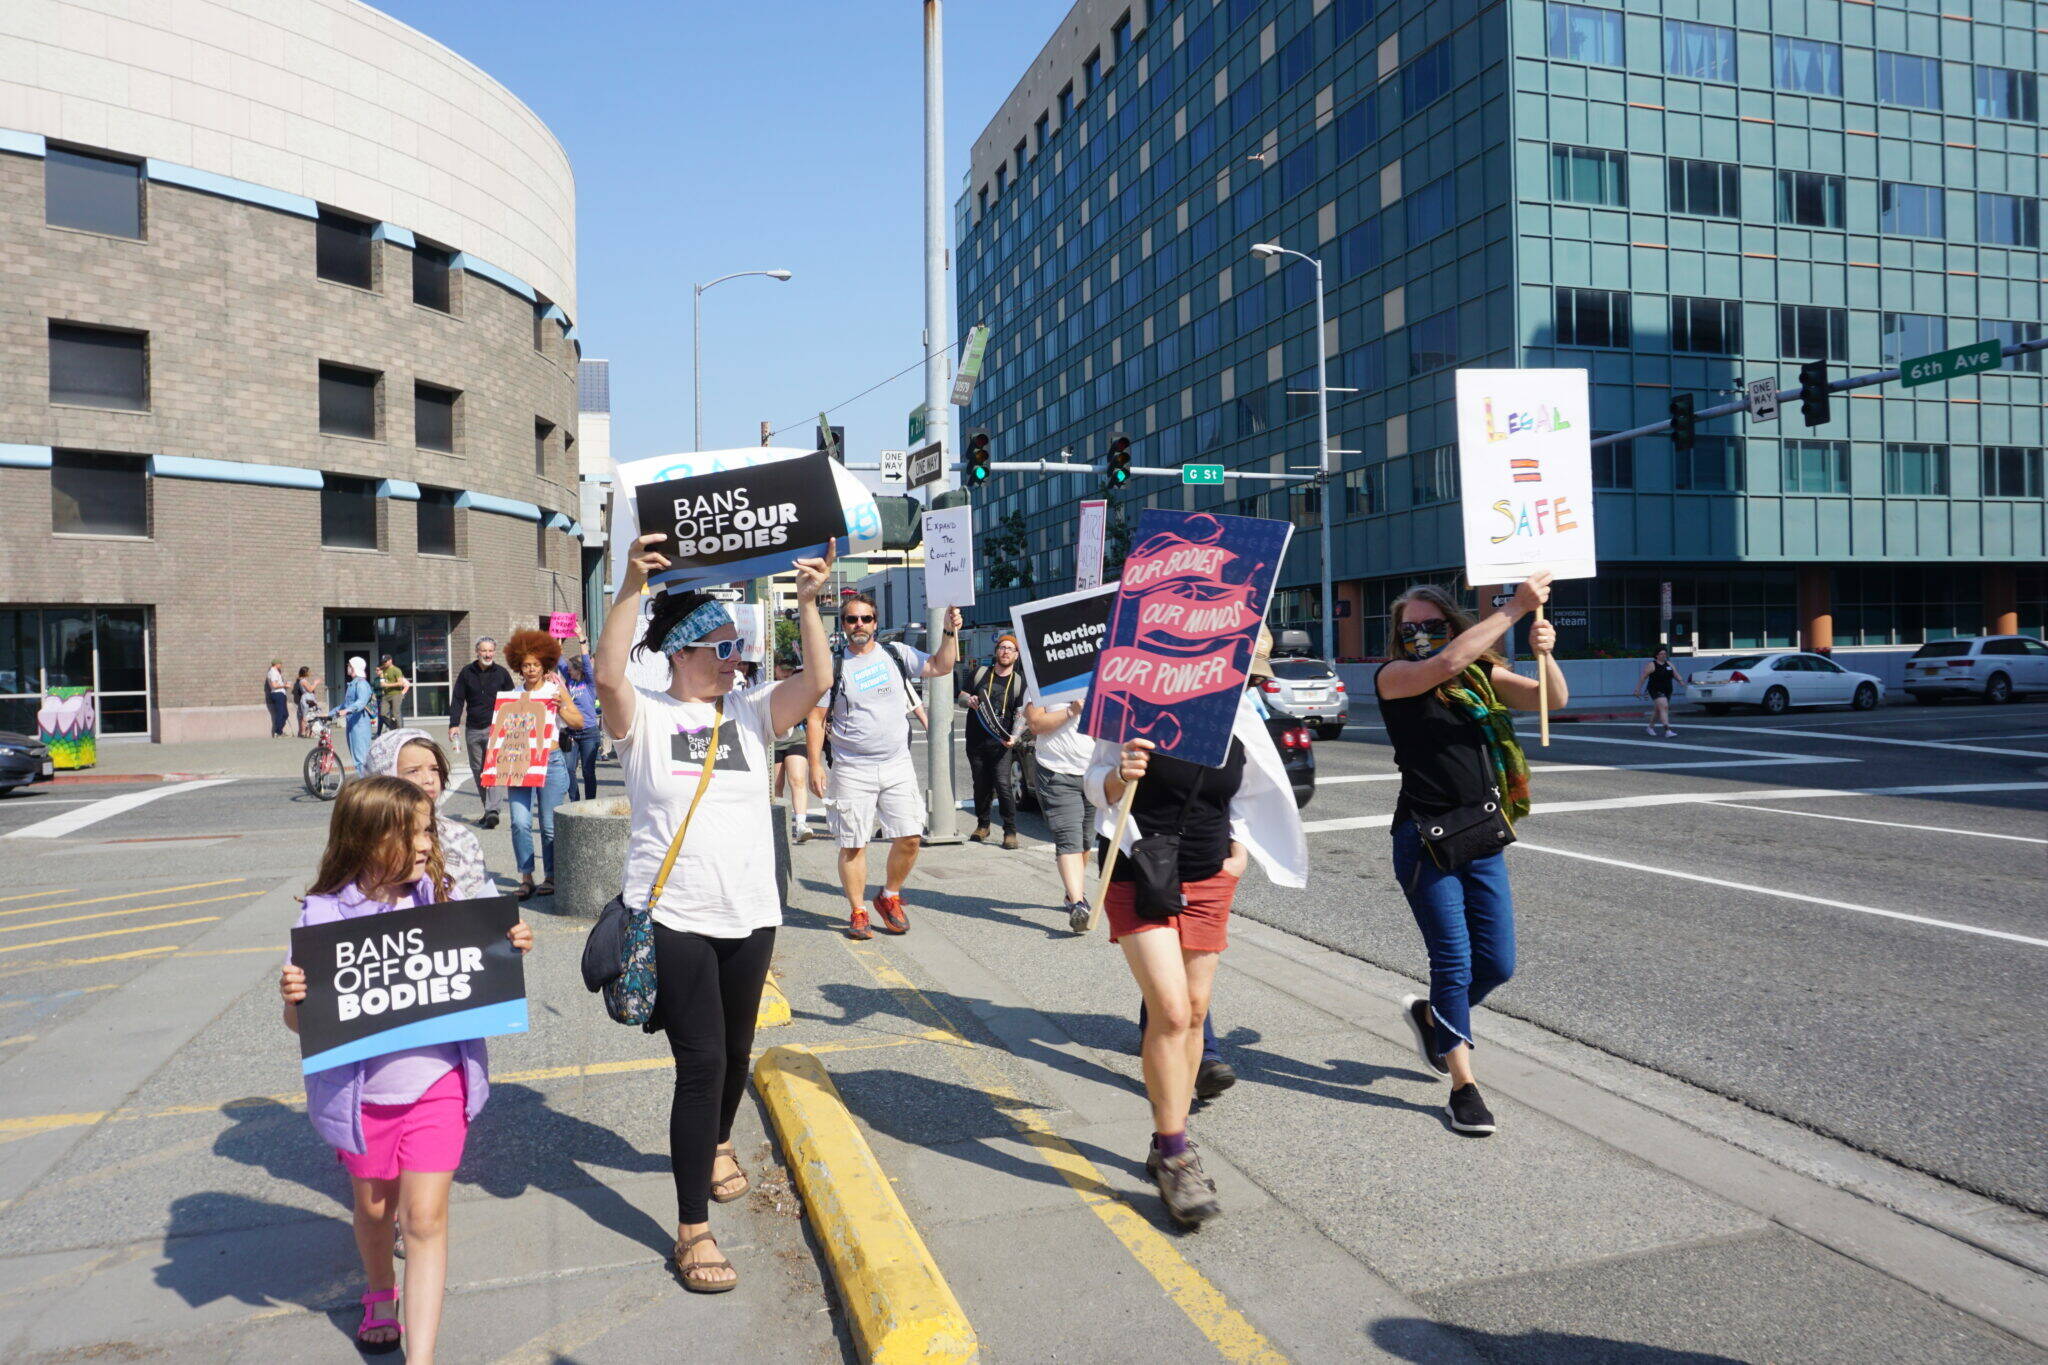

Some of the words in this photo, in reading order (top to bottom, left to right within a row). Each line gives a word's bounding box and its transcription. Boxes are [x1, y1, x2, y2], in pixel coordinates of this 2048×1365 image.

[1911, 361, 1943, 379] 6th
[1954, 352, 1990, 370] Ave
[1753, 381, 1771, 394] ONE
[1754, 392, 1772, 405] WAY
[885, 453, 903, 461] ONE
[885, 462, 903, 470] WAY
[915, 460, 926, 476] ONE
[927, 454, 938, 471] WAY
[1190, 469, 1198, 479] G
[1203, 469, 1217, 480] St
[674, 487, 750, 520] BANS
[675, 513, 731, 540] OFF
[733, 503, 799, 531] OUR
[1490, 496, 1578, 544] SAFE
[679, 525, 788, 557] BODIES
[1125, 560, 1164, 586] OUR
[1163, 547, 1224, 575] BODIES
[1143, 603, 1185, 625] OUR
[1183, 601, 1244, 633] MINDS
[1043, 622, 1107, 647] Abortion
[1046, 640, 1094, 662] Health
[1102, 657, 1152, 686] OUR
[1152, 657, 1227, 695] POWER
[336, 928, 424, 968] BANS
[334, 959, 399, 993] OFF
[404, 947, 484, 980] OUR
[338, 974, 472, 1022] BODIES
